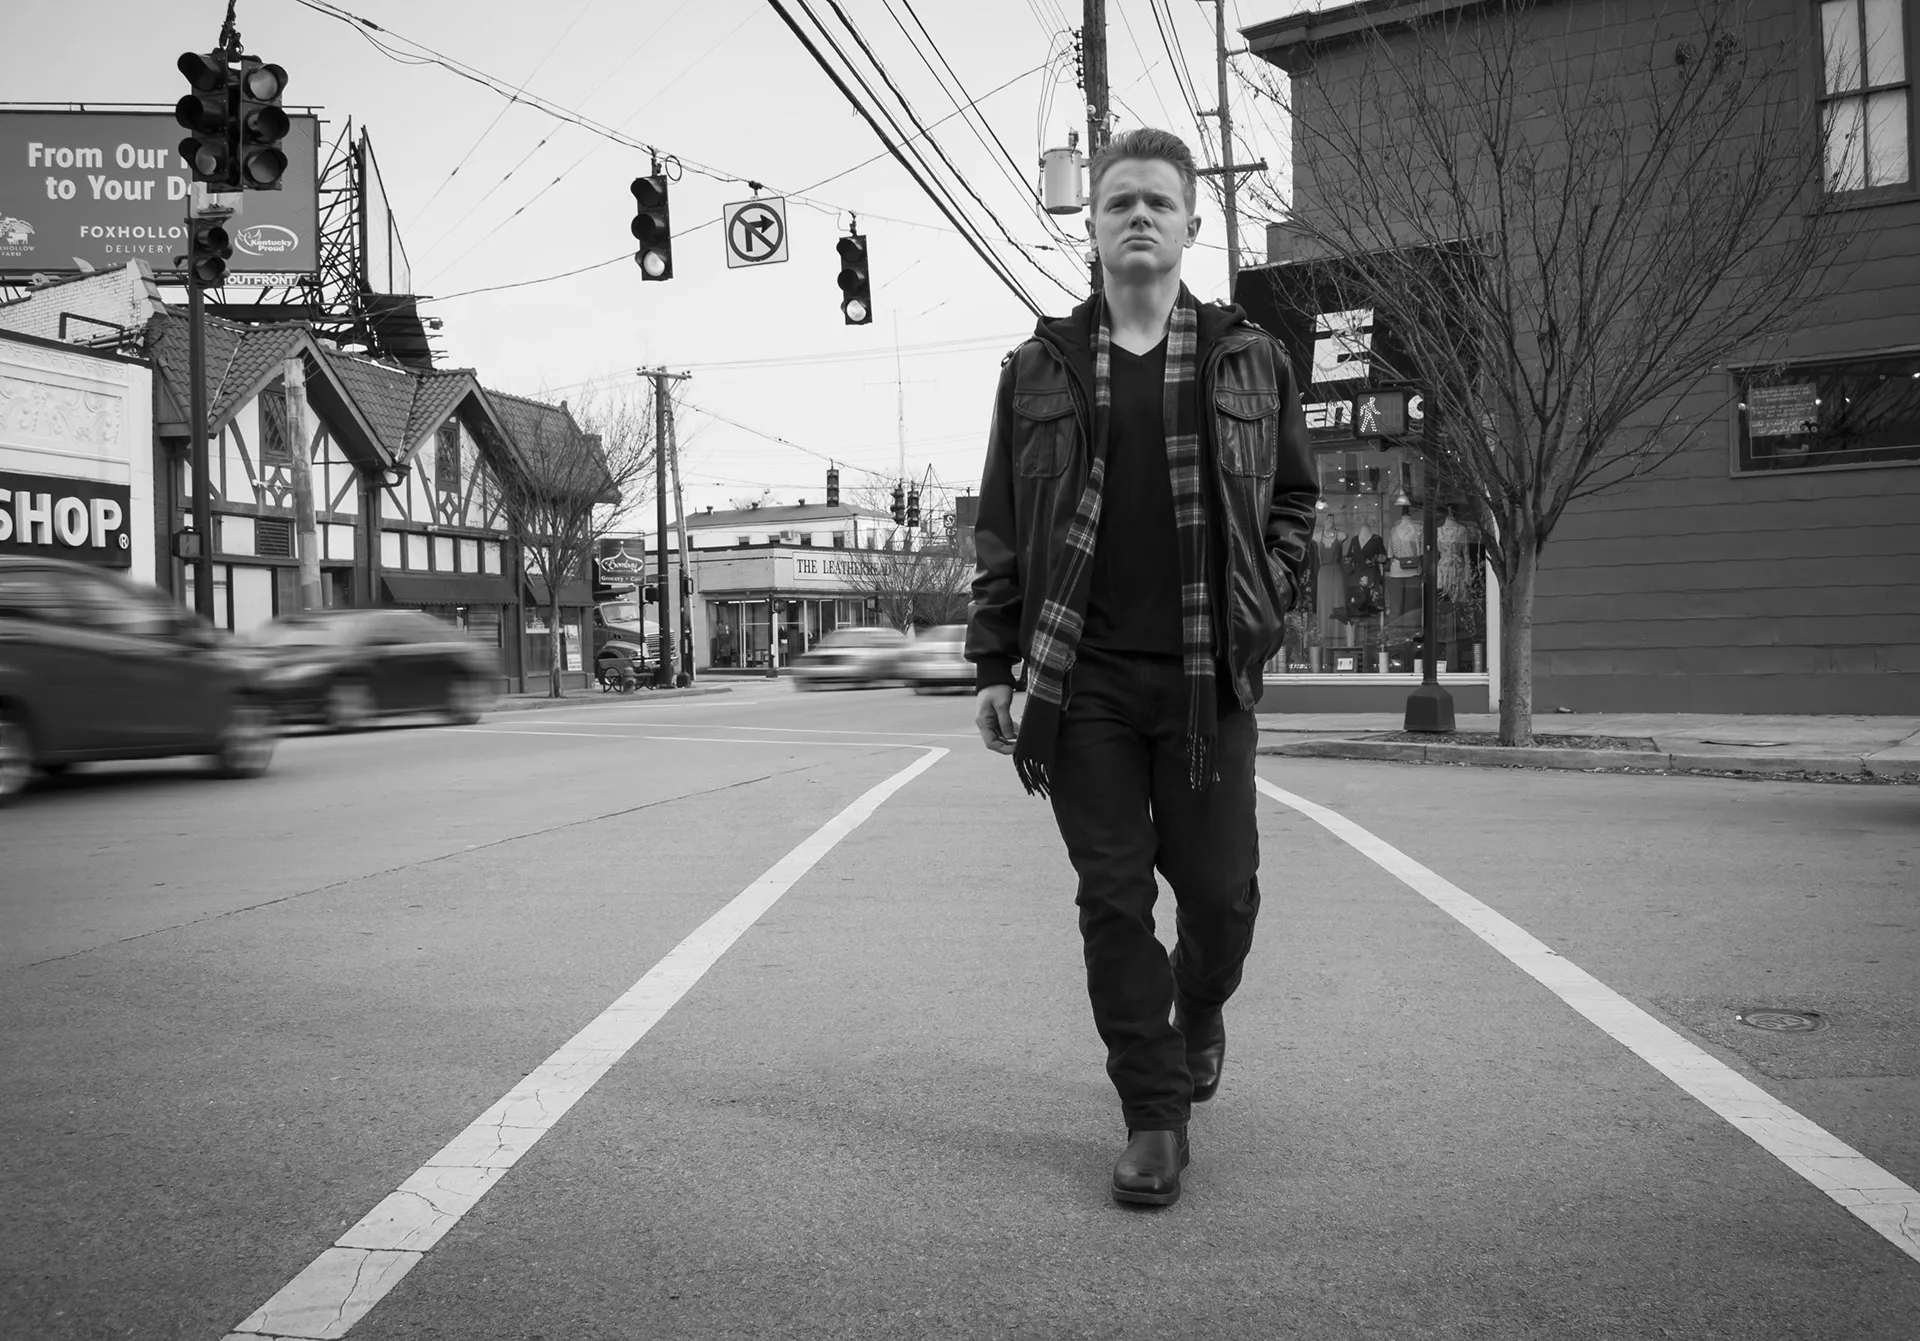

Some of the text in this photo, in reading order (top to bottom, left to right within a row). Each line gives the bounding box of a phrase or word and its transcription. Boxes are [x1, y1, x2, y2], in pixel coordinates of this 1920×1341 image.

[28, 142, 103, 169] From
[115, 142, 169, 169] Our
[45, 174, 77, 201] to
[88, 174, 156, 201] Your
[251, 239, 293, 247] Kentucky
[105, 244, 174, 254] DELIVERY
[227, 275, 297, 285] OUTFRONT
[796, 559, 818, 574] THE
[601, 575, 624, 583] Grocery
